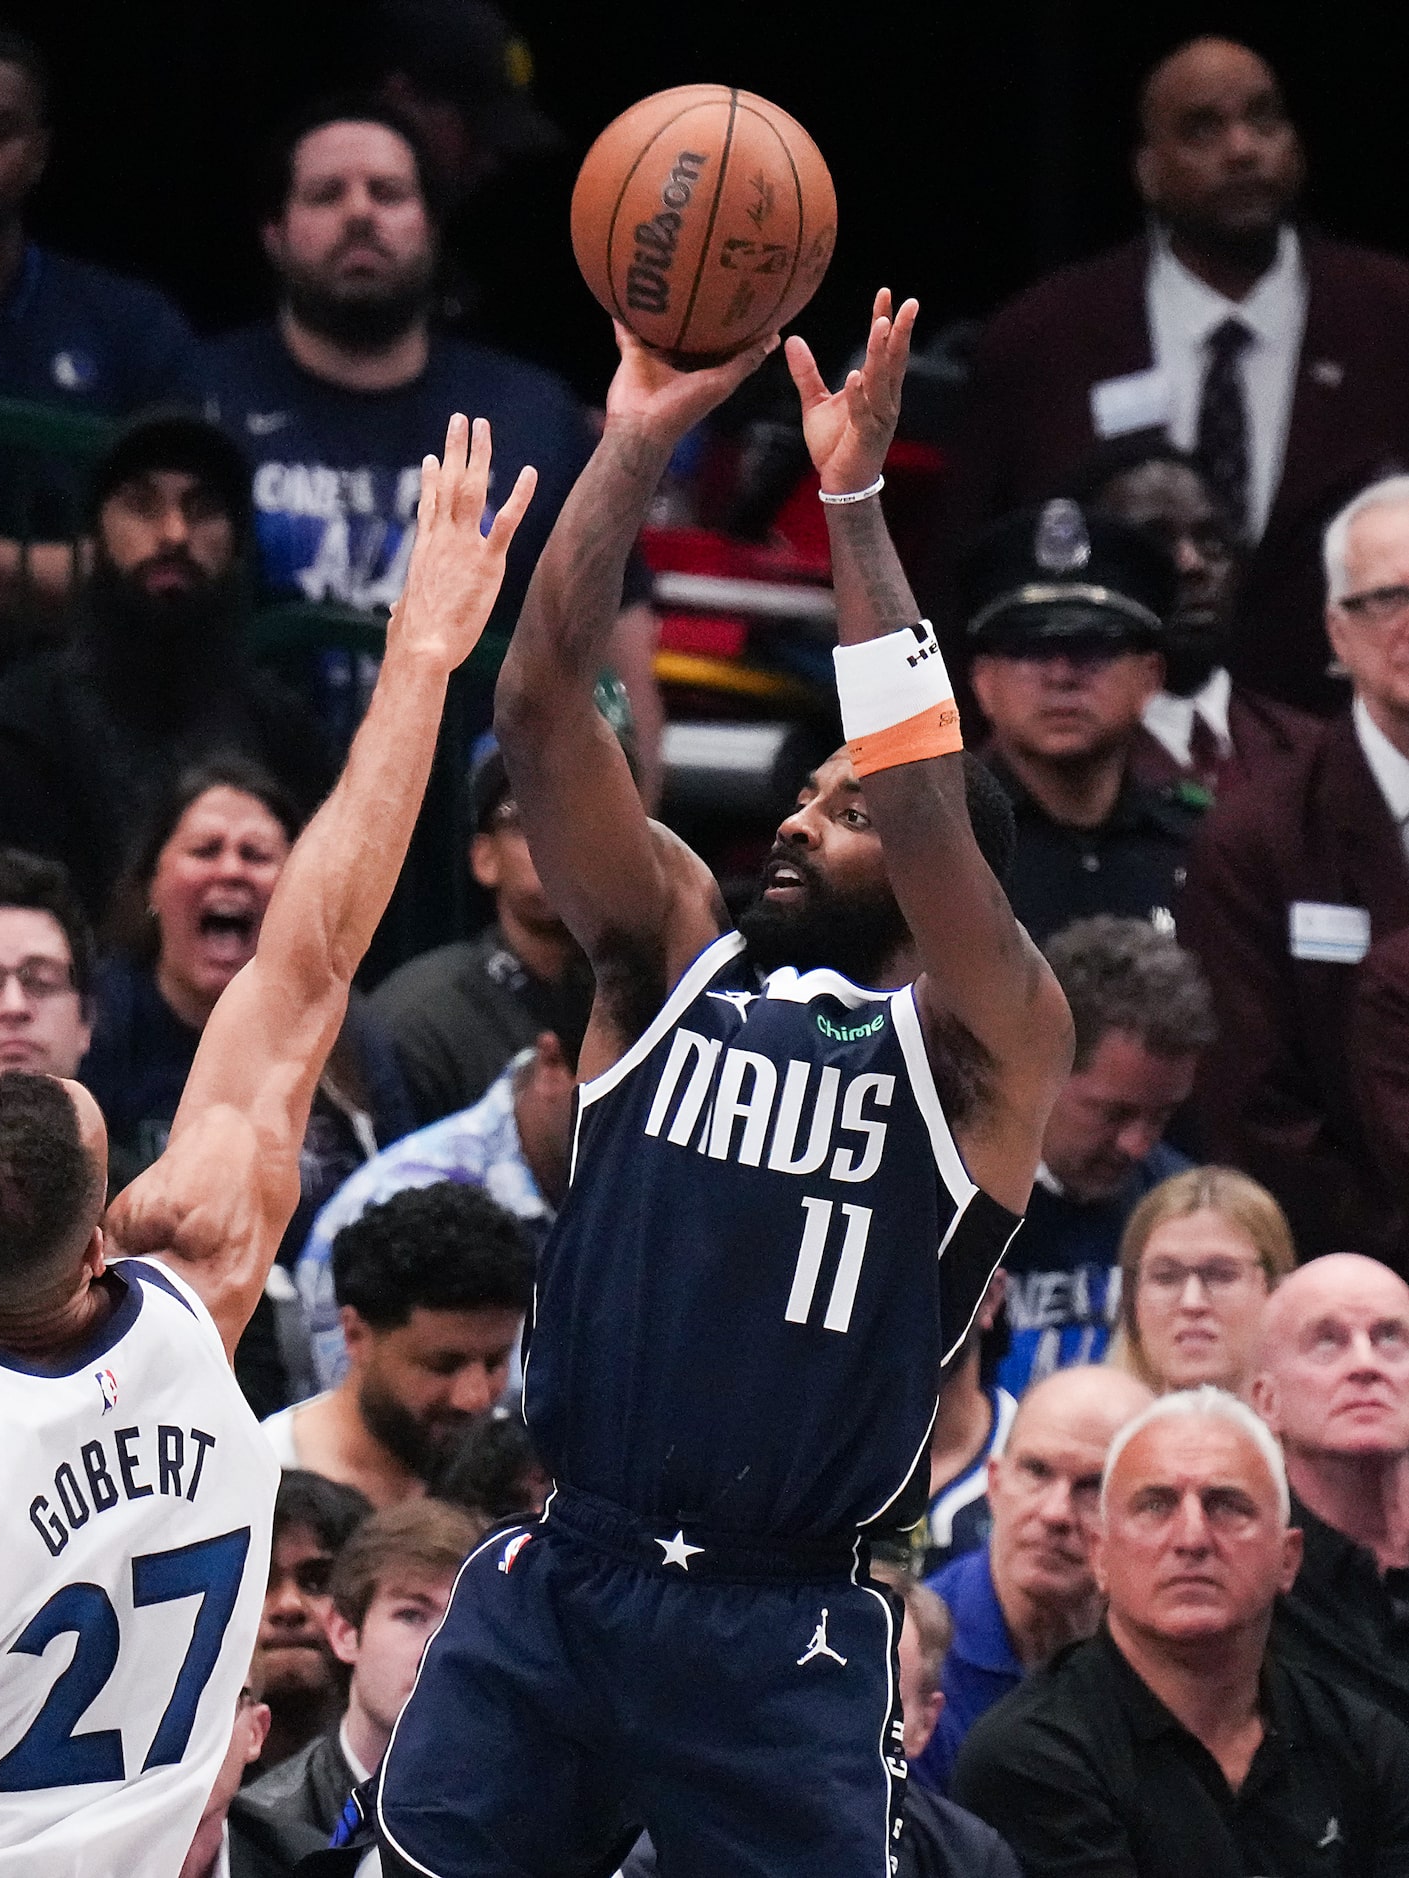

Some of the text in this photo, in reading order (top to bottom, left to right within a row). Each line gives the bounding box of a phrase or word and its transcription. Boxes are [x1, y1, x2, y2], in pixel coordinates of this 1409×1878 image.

[627, 151, 709, 315] Wilson
[644, 1028, 896, 1183] MAVS
[785, 1196, 873, 1333] 11
[29, 1424, 216, 1557] GOBERT
